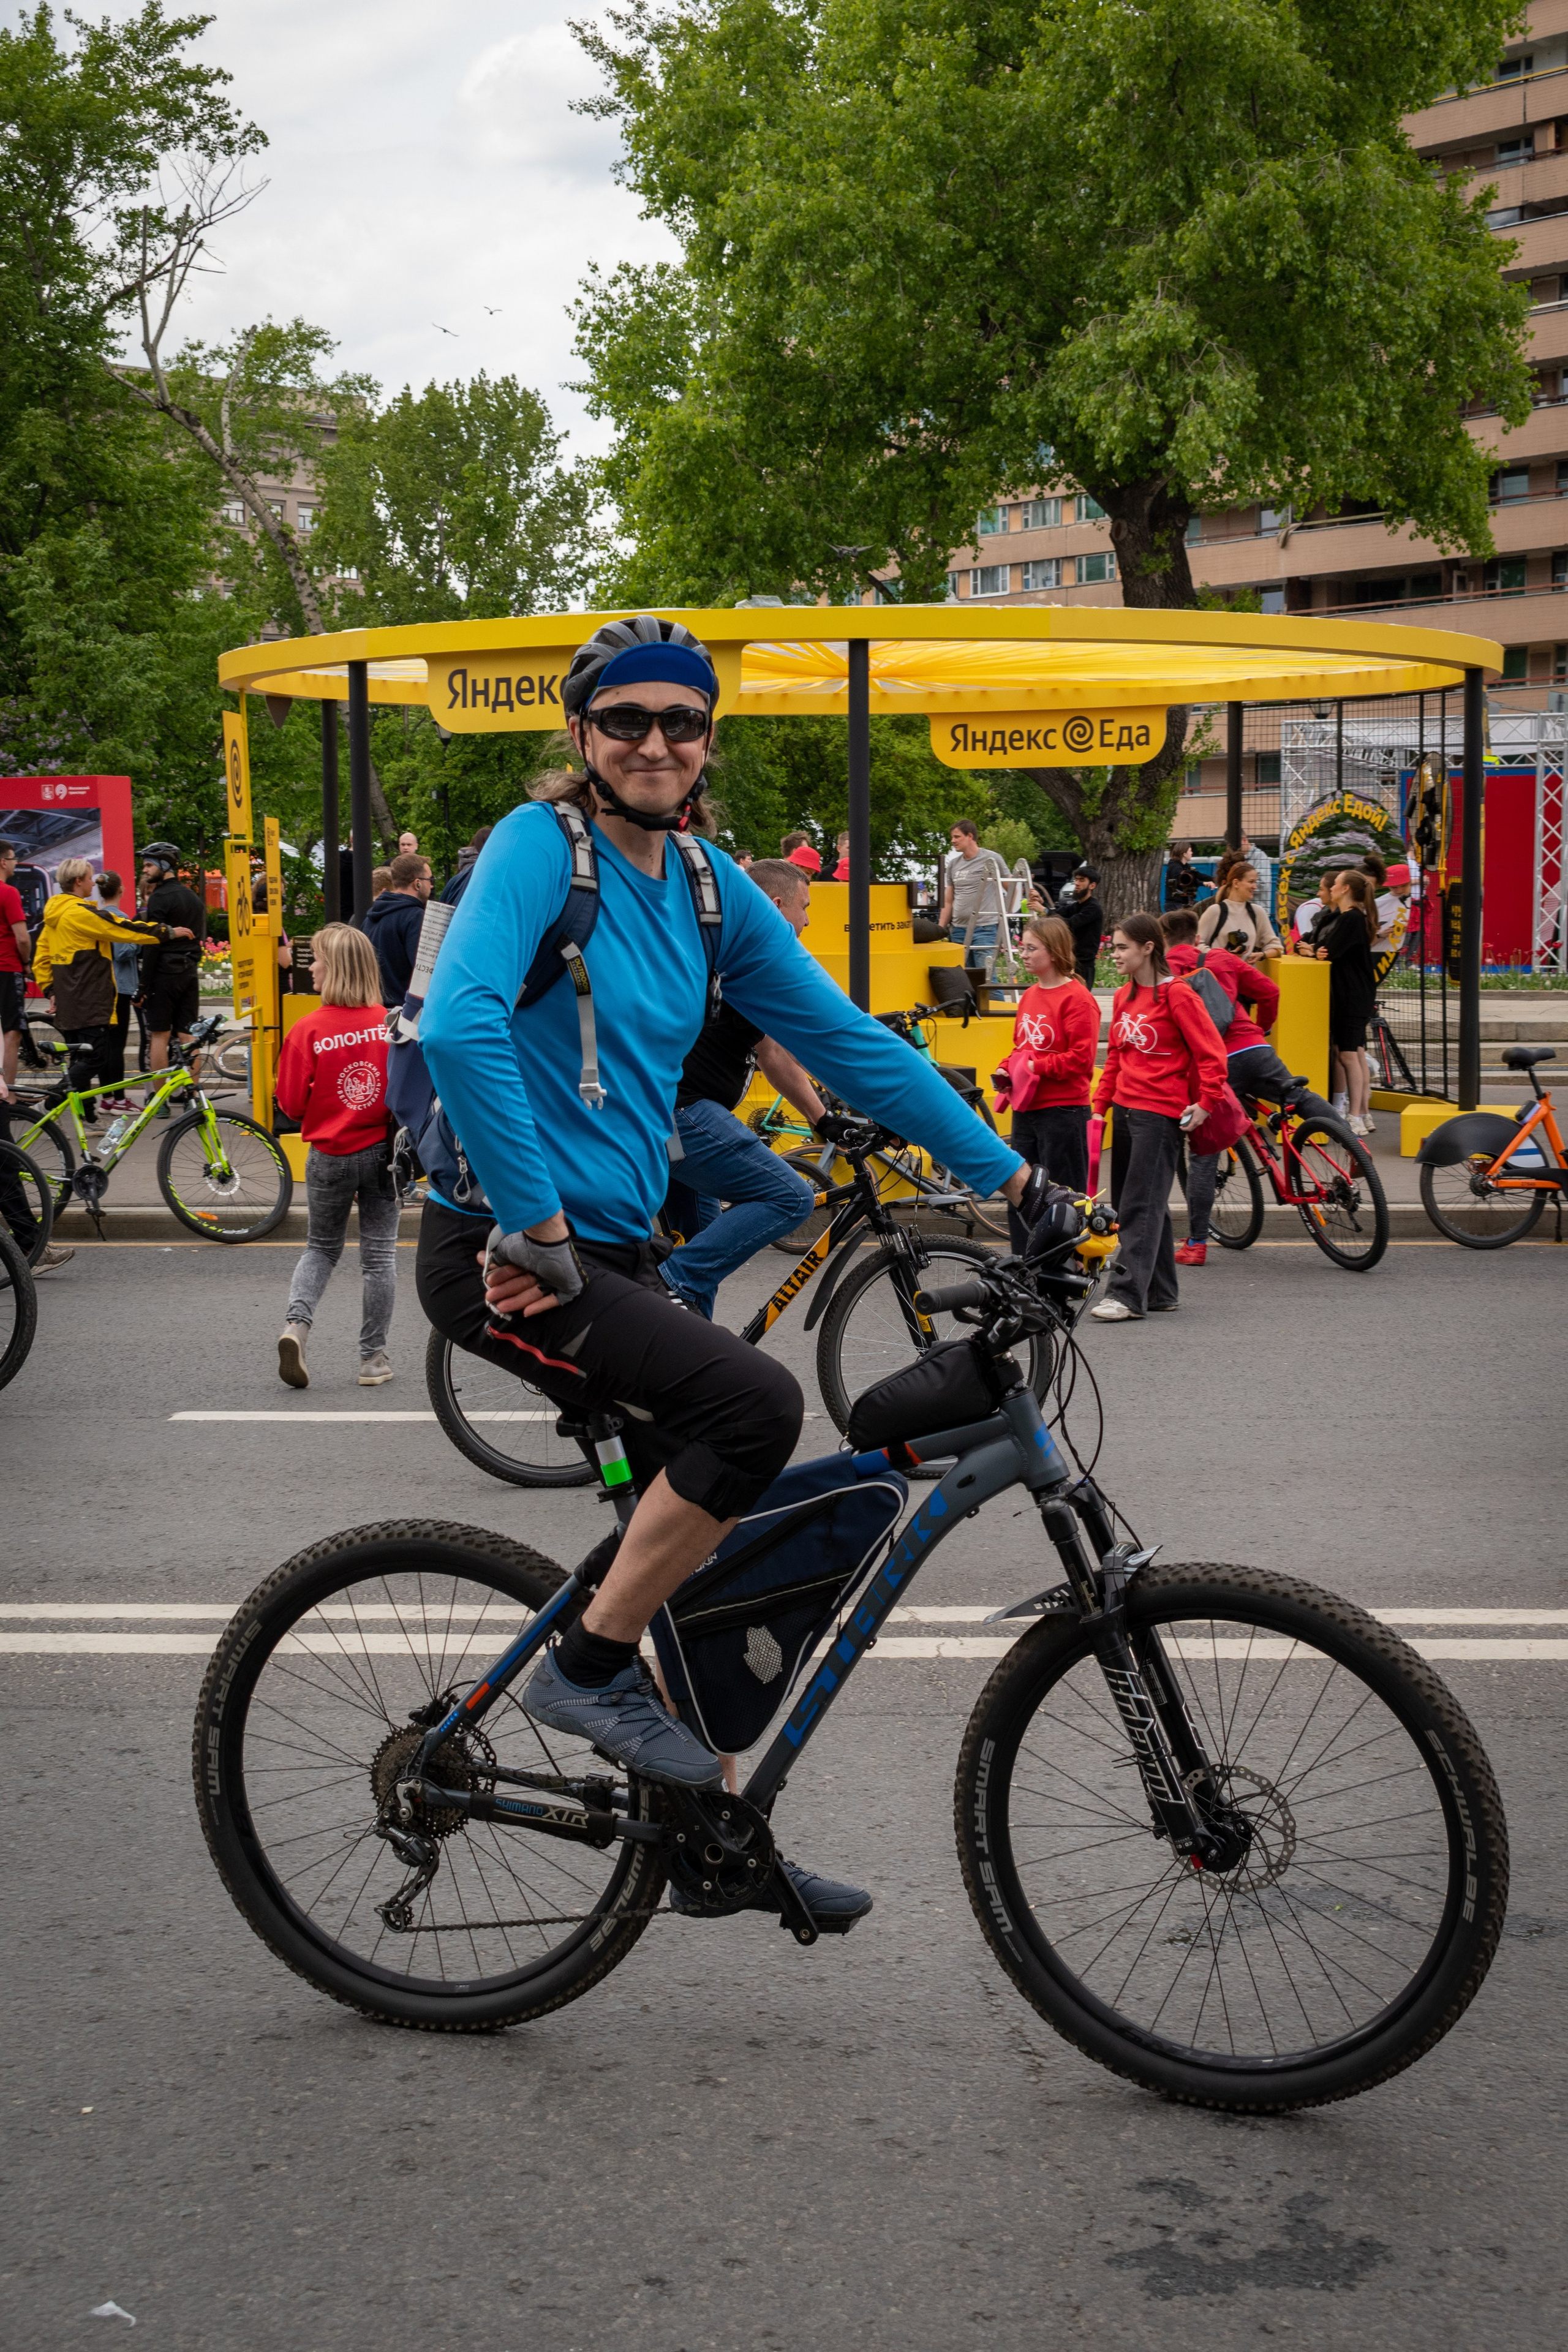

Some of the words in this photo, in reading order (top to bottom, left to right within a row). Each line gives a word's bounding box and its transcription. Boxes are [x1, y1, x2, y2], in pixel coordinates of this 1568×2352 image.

[951, 723, 1057, 755] Яндекс
[1099, 718, 1150, 752] Еда
[1290, 799, 1341, 851] Яндекс
[1343, 794, 1389, 831] Едой!
[844, 922, 895, 932] ветить
[337, 1061, 381, 1084] МОСКОВСКИЙ
[1095, 1218, 1102, 1229] 8
[774, 1250, 824, 1313] ALTAIR
[212, 1619, 263, 1721] SMART
[207, 1725, 221, 1795] SAM
[496, 1798, 543, 1815] SHIMANO
[541, 1806, 589, 1826] XTR
[974, 1737, 996, 1855] SMART
[1424, 1729, 1477, 1923] SCHWALBE
[589, 1787, 650, 1953] SWALBE
[979, 1861, 1013, 1933] SAM
